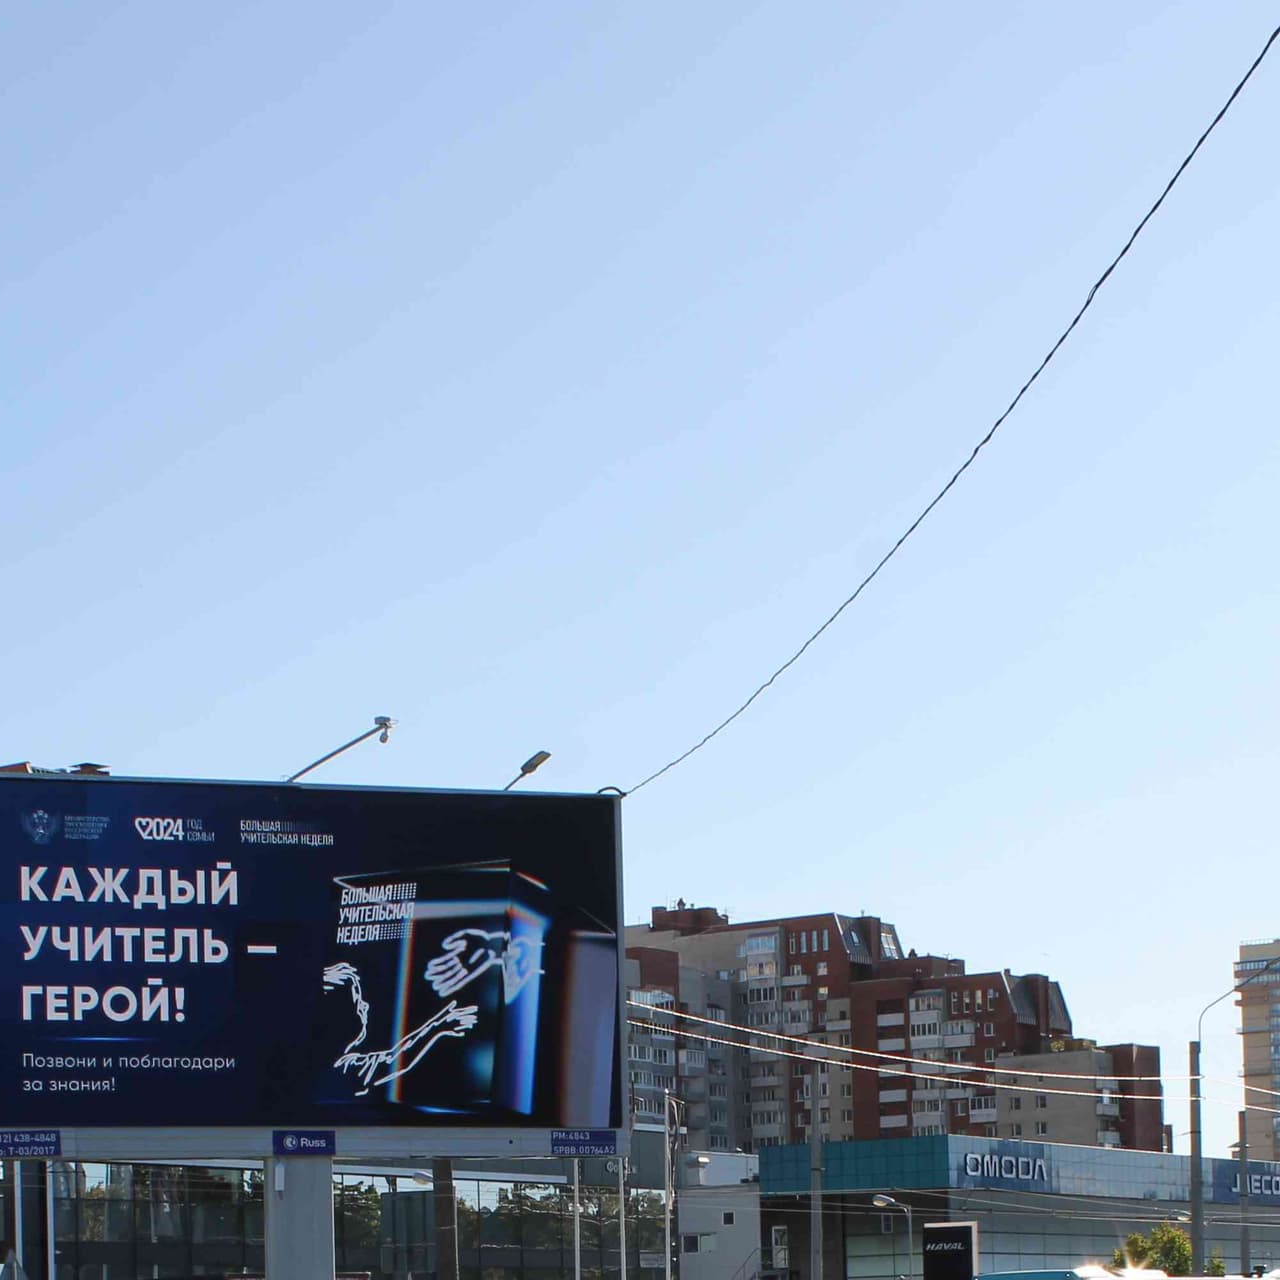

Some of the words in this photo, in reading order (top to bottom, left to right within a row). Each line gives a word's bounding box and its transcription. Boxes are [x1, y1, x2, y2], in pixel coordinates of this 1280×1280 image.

[240, 820, 281, 832] БОЛЬШАЯ
[240, 832, 299, 845] УЧИТЕЛЬСКАЯ
[300, 834, 334, 847] НЕДЕЛЯ
[20, 862, 239, 910] КАЖДЫЙ
[341, 884, 393, 906] БОЛЬШАЯ
[339, 902, 415, 924] УЧИТЕЛЬСКАЯ
[20, 926, 229, 963] УЧИТЕЛЬ
[336, 924, 380, 945] НЕДЕЛЯ
[22, 978, 186, 1022] ГЕРОЙ!
[23, 1053, 97, 1069] Позвони
[103, 1056, 113, 1068] и
[119, 1055, 236, 1071] поблагодари
[22, 1081, 43, 1092] за
[49, 1077, 116, 1092] знания!
[300, 1137, 327, 1148] Russ
[965, 1153, 1048, 1181] OMODA
[926, 1243, 965, 1251] HAVAL
